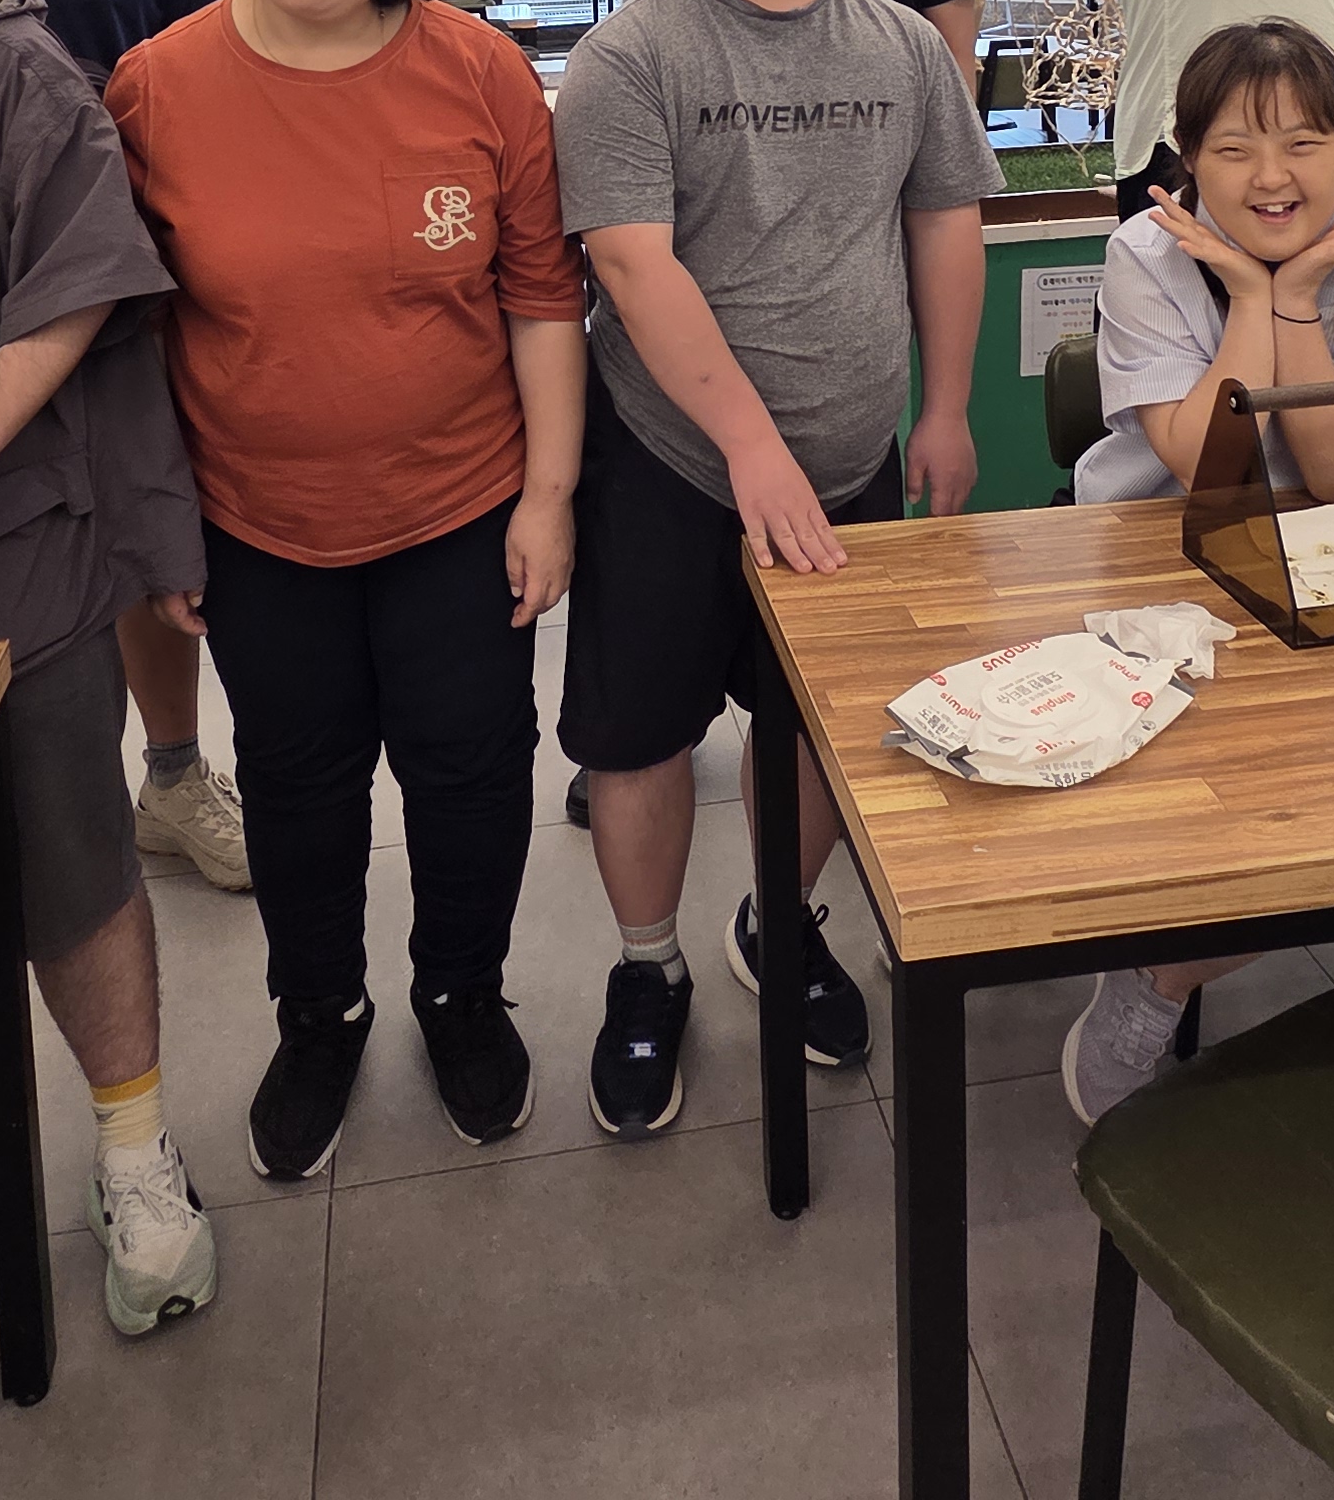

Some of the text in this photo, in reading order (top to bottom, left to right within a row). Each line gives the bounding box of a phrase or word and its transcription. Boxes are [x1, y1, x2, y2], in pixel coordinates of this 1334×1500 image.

[697, 100, 894, 137] MOVEMENT
[1027, 671, 1063, 691] 도톰한
[995, 684, 1032, 706] 물티슈
[1030, 691, 1076, 716] simplus
